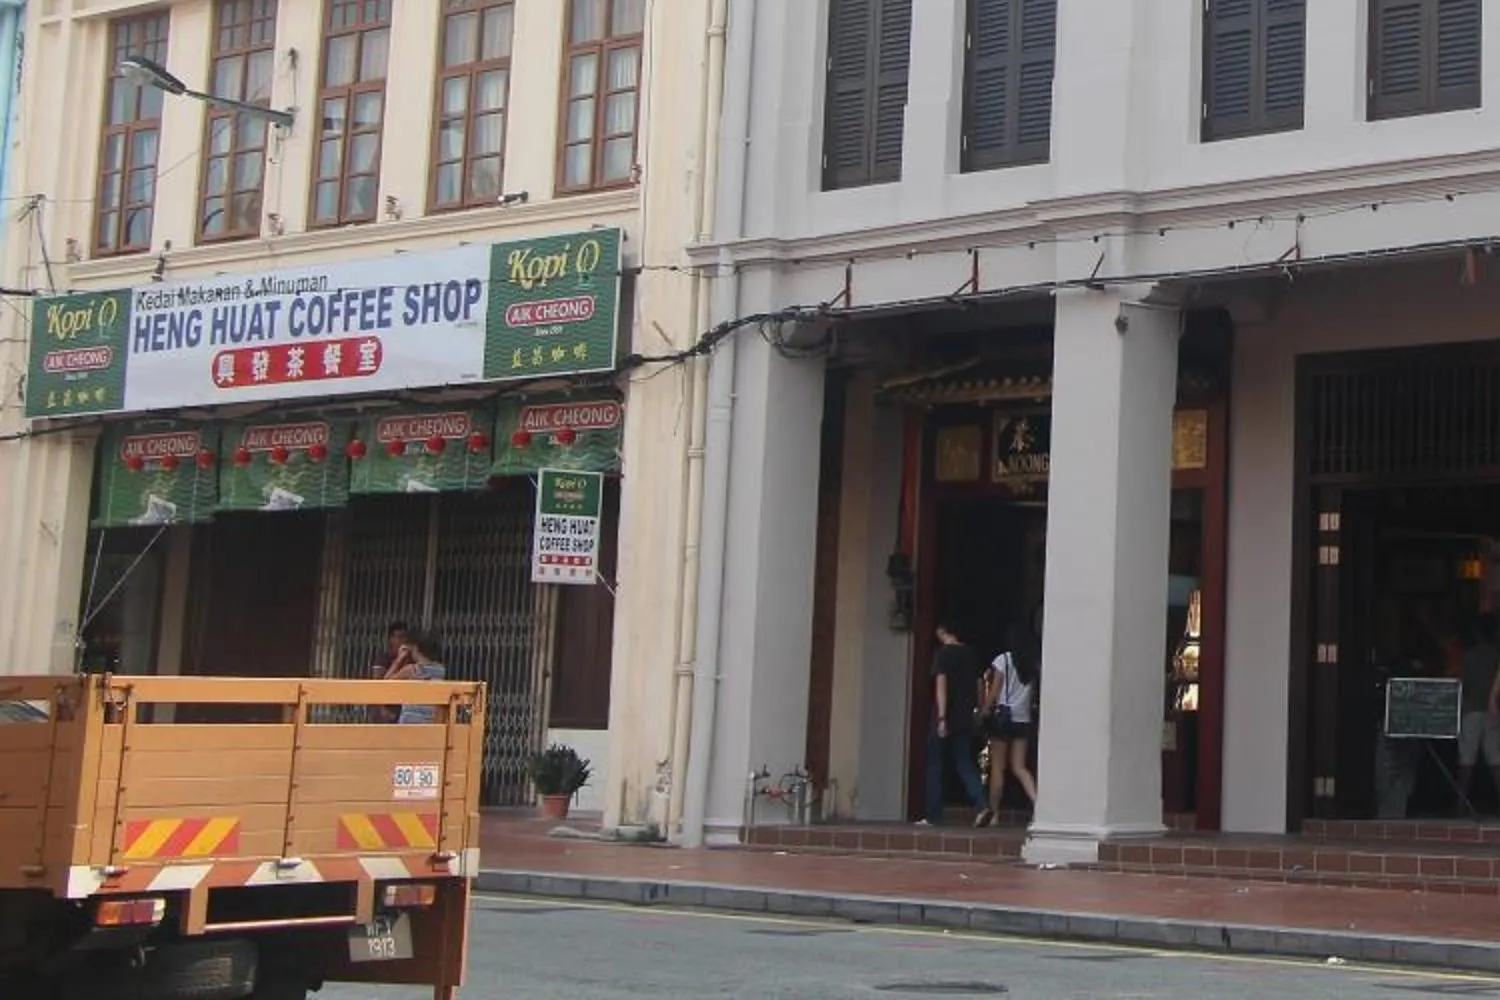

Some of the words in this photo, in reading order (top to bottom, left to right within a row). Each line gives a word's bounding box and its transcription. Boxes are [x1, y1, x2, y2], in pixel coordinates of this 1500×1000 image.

[508, 243, 571, 289] Kopi
[136, 291, 175, 311] Kedai
[179, 283, 241, 307] Makanan
[245, 281, 257, 298] &
[261, 274, 329, 294] Minuman
[47, 299, 94, 340] Kopi
[133, 309, 202, 353] HENG
[210, 299, 280, 345] HUAT
[288, 286, 396, 337] COFFEE
[402, 278, 482, 326] SHOP
[511, 308, 532, 324] AIK
[535, 301, 590, 320] CHEONG
[383, 421, 404, 437] AIK
[409, 416, 465, 437] CHEONG
[526, 411, 549, 427] AIK
[553, 404, 614, 425] CHEONG
[127, 441, 145, 454] AIK
[148, 436, 196, 454] CHEONG
[248, 431, 268, 446] AIK
[271, 427, 325, 444] CHEONG
[541, 517, 567, 534] HENG
[569, 519, 596, 536] HUAT
[540, 536, 571, 551] COFFEE
[573, 537, 594, 553] SHOP
